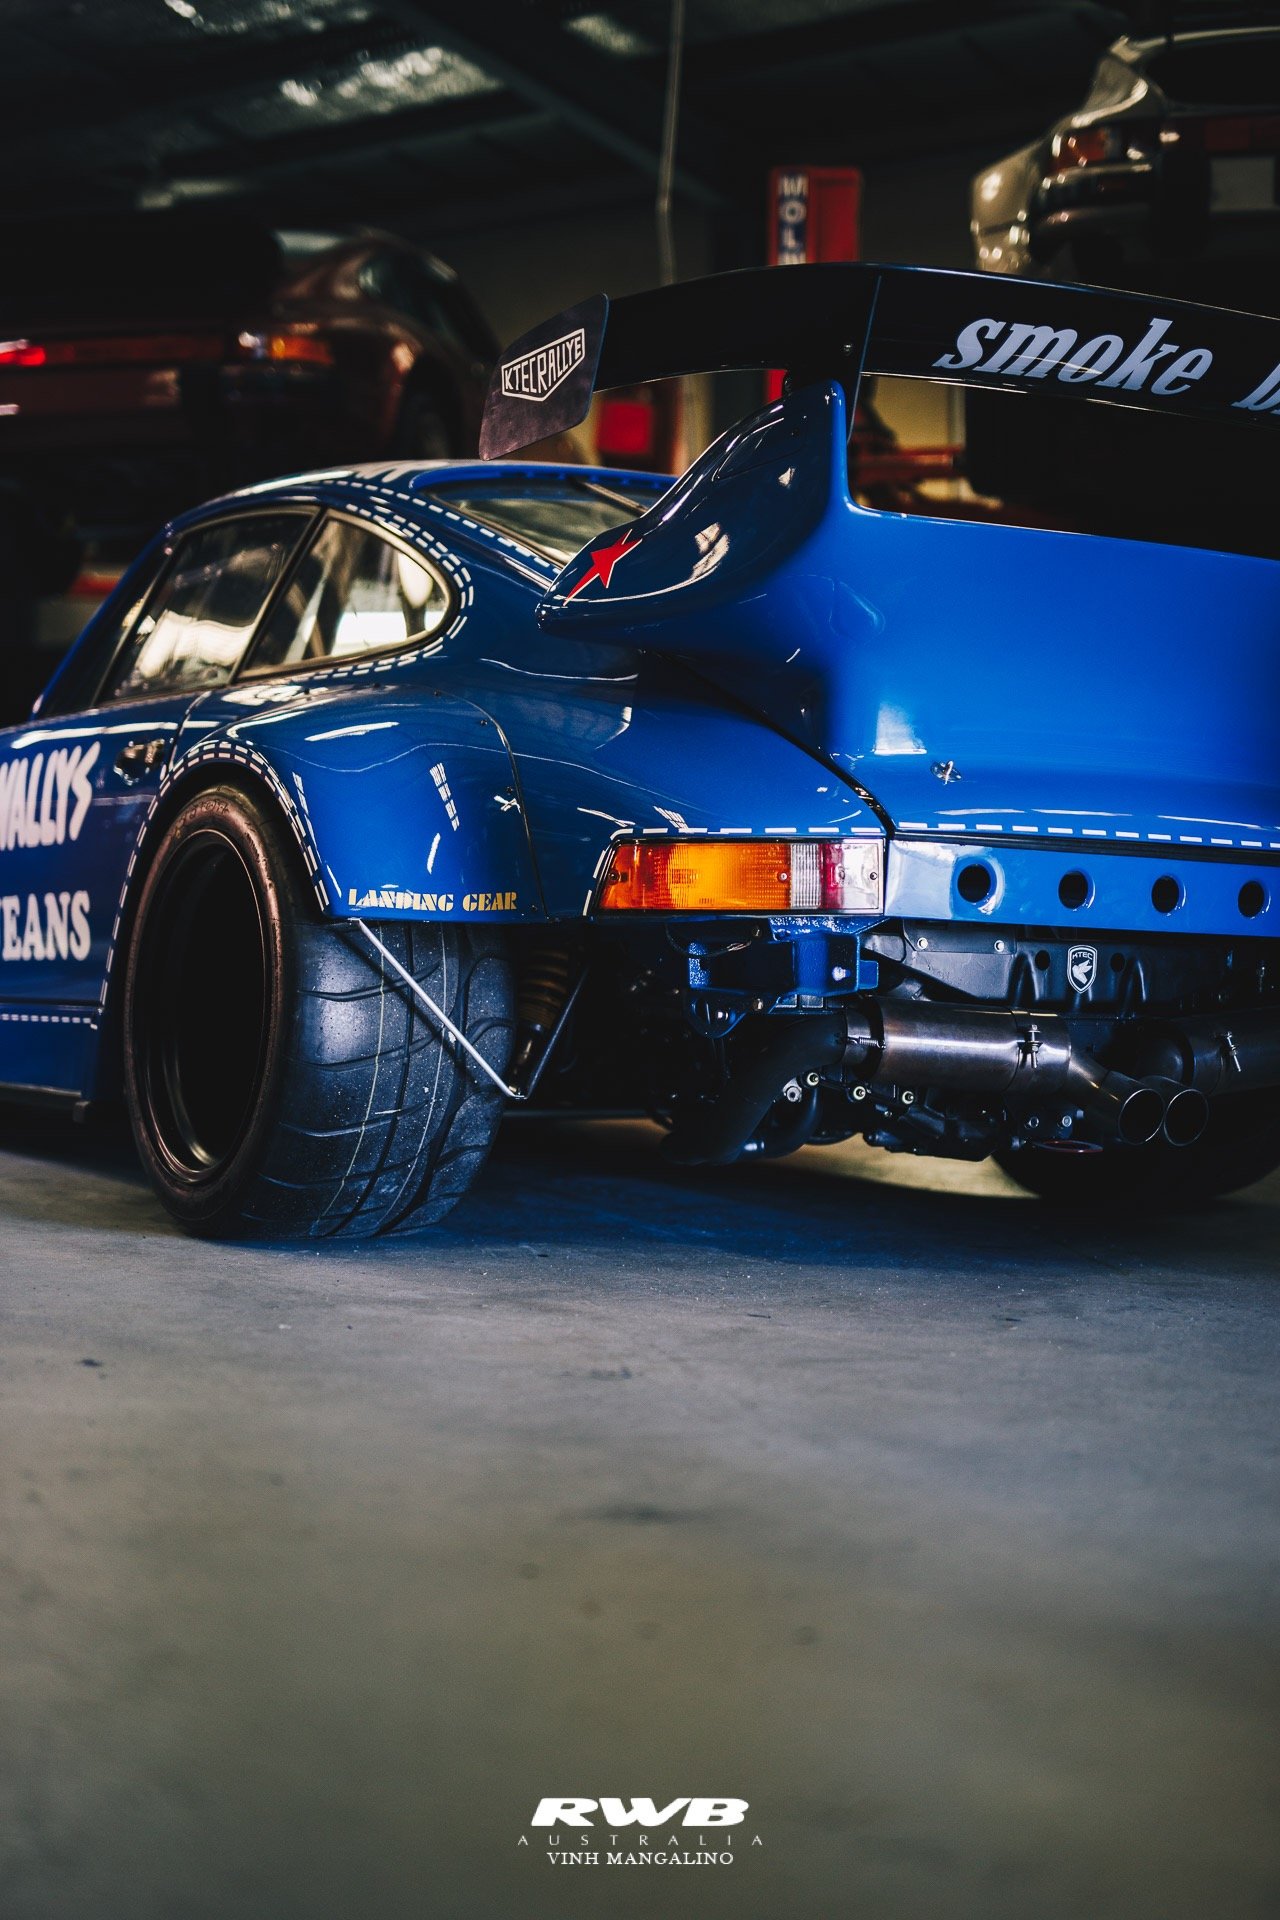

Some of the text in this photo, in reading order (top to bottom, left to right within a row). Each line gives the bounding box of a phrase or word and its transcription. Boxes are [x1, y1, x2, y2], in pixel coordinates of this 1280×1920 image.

[504, 335, 582, 394] KTECRALLYE
[932, 317, 1213, 395] smoke
[0, 890, 91, 961] EANS
[348, 888, 517, 912] LANDING GEAR
[1072, 951, 1093, 960] KTEC
